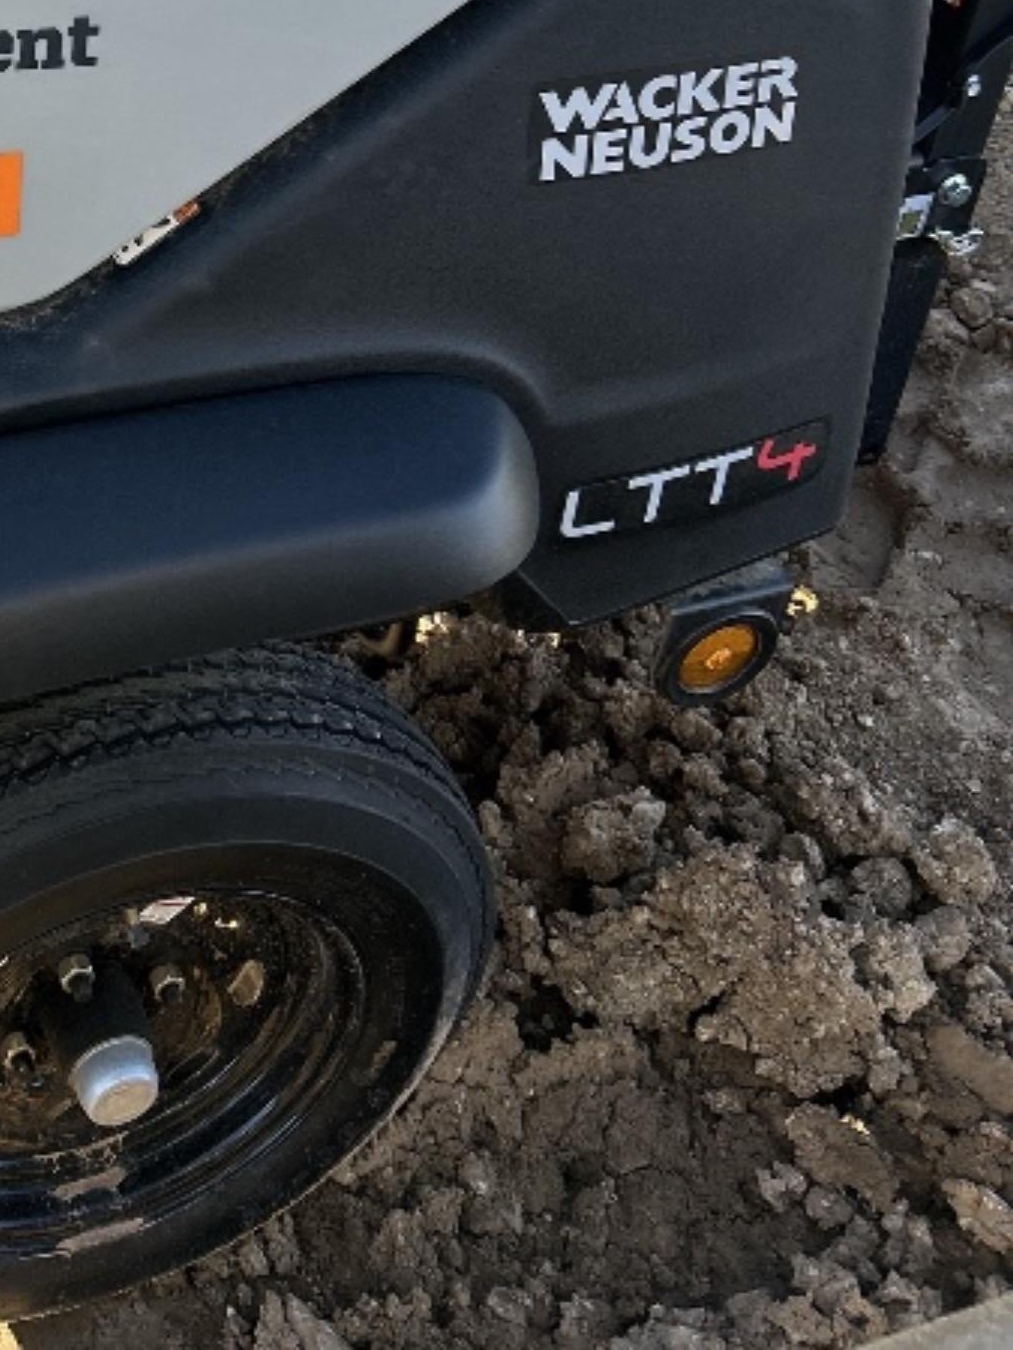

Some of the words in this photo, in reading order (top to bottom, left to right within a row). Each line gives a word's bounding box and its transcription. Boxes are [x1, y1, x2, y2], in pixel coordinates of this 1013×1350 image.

[539, 56, 798, 132] WACKER
[539, 101, 796, 181] NEUSON
[560, 438, 816, 538] LTT4
